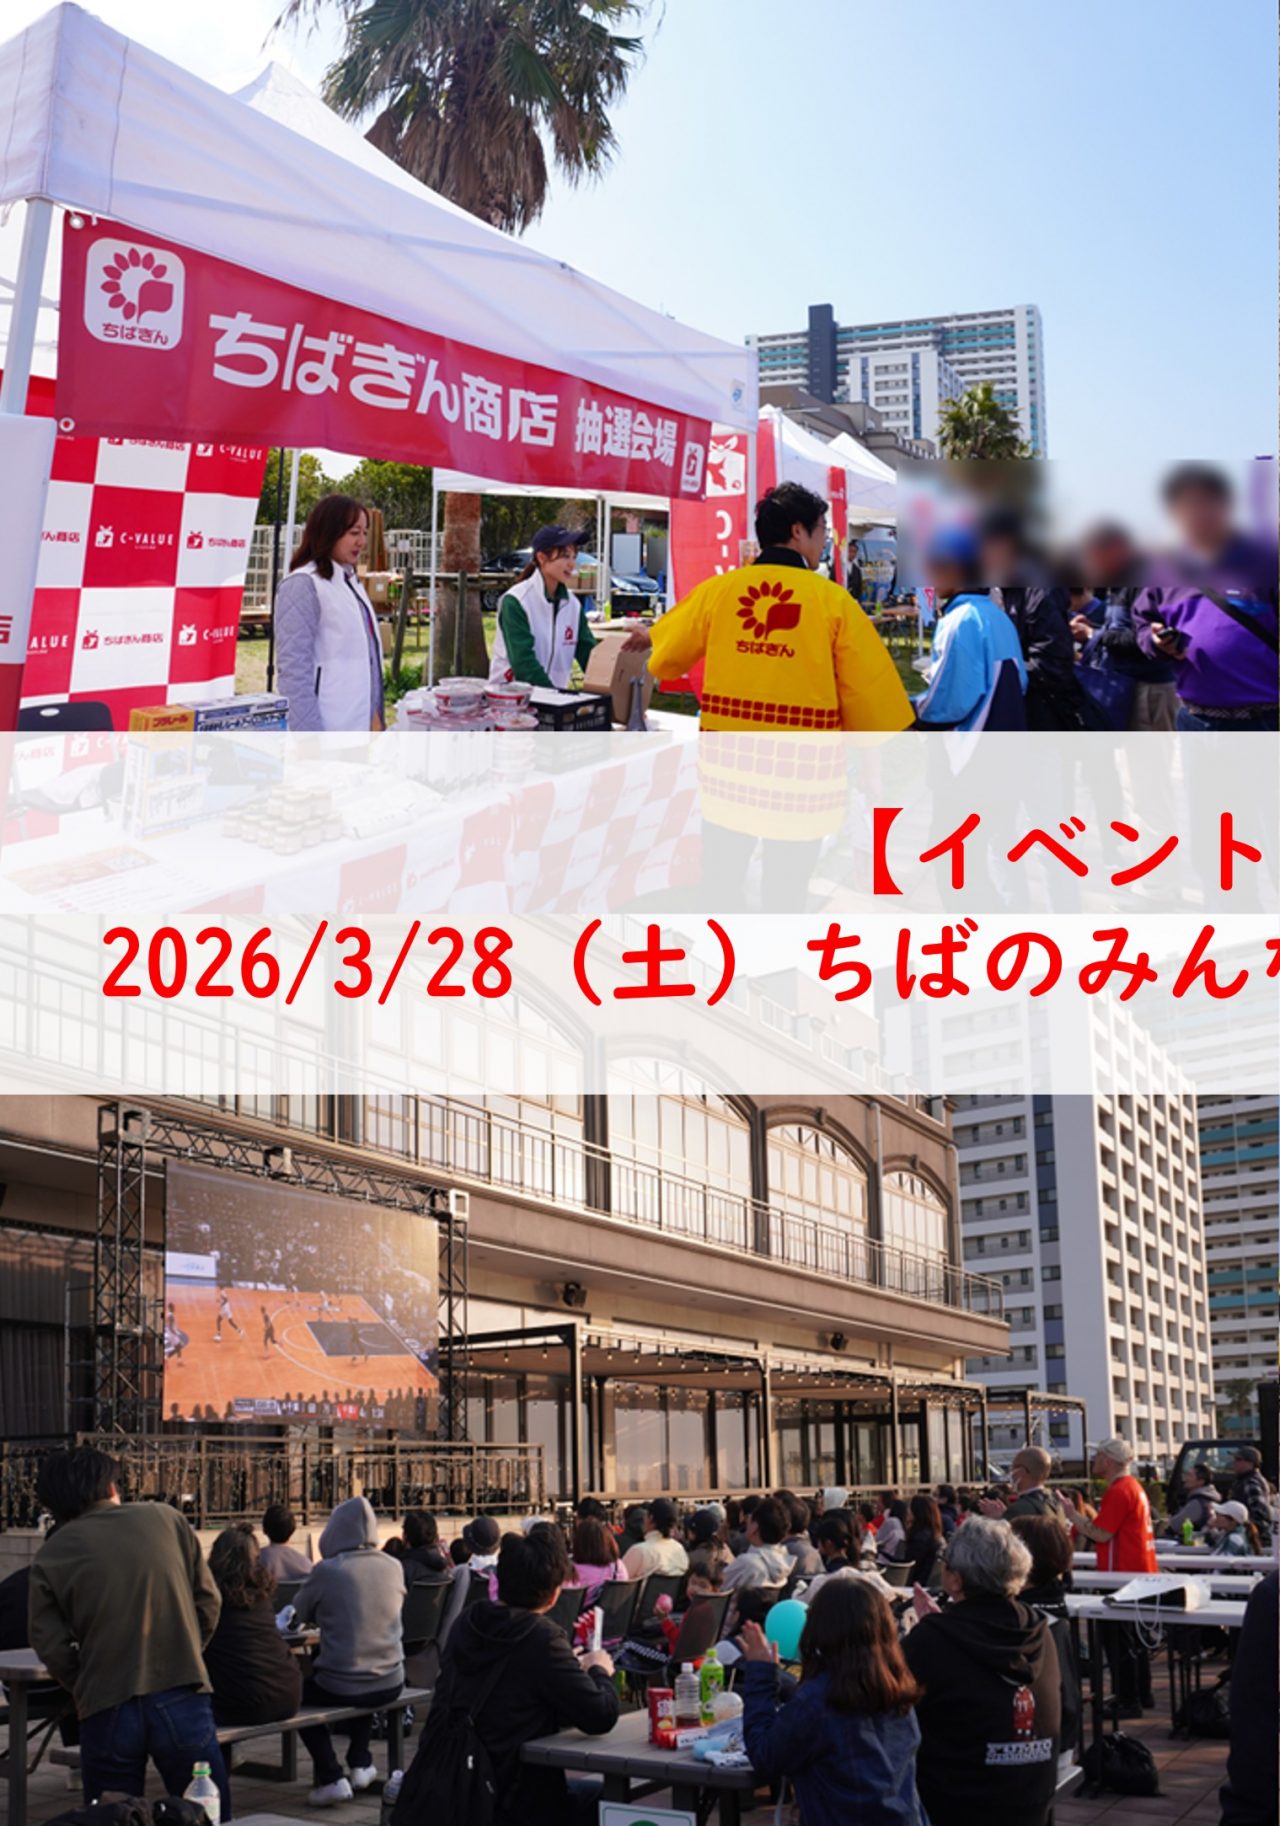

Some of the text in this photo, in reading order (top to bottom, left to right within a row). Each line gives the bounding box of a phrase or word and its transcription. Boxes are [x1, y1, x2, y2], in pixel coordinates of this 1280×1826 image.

[102, 322, 169, 345] ちばぎん
[209, 312, 678, 467] ちばぎん商店 抽選会場
[120, 532, 174, 546] C-VALUE
[736, 639, 796, 658] ちばぎん
